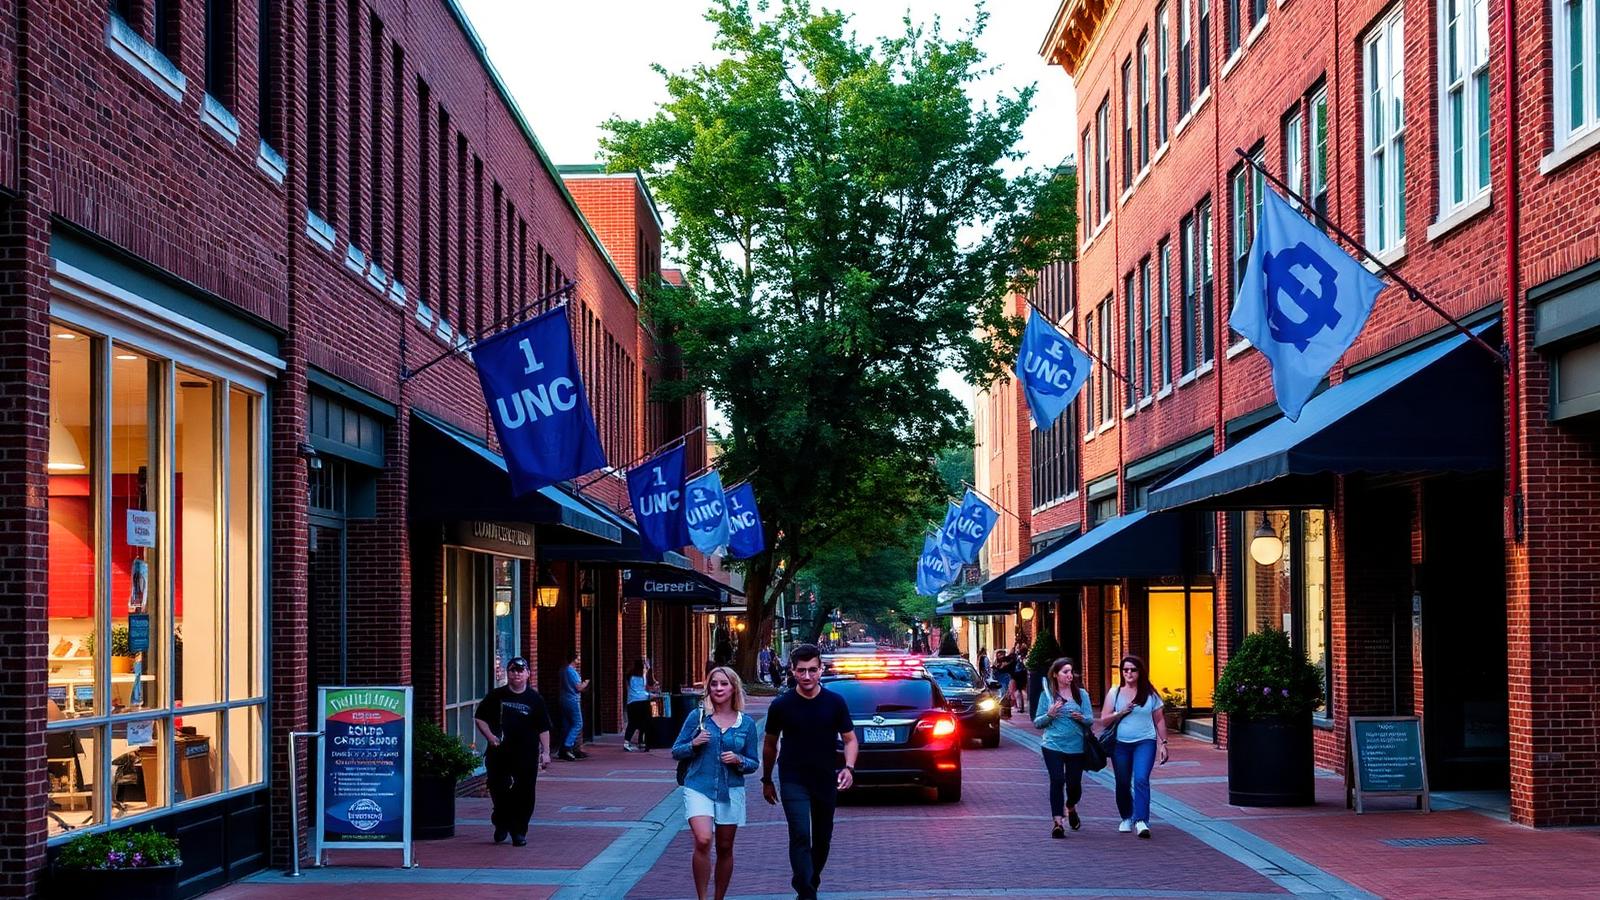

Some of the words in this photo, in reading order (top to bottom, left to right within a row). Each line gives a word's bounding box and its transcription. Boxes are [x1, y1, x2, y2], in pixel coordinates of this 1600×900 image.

[519, 338, 544, 374] 1
[1024, 351, 1072, 389] UNC
[496, 377, 577, 429] UNC
[653, 467, 666, 486] 1
[640, 490, 680, 516] UNC
[731, 495, 742, 510] 1
